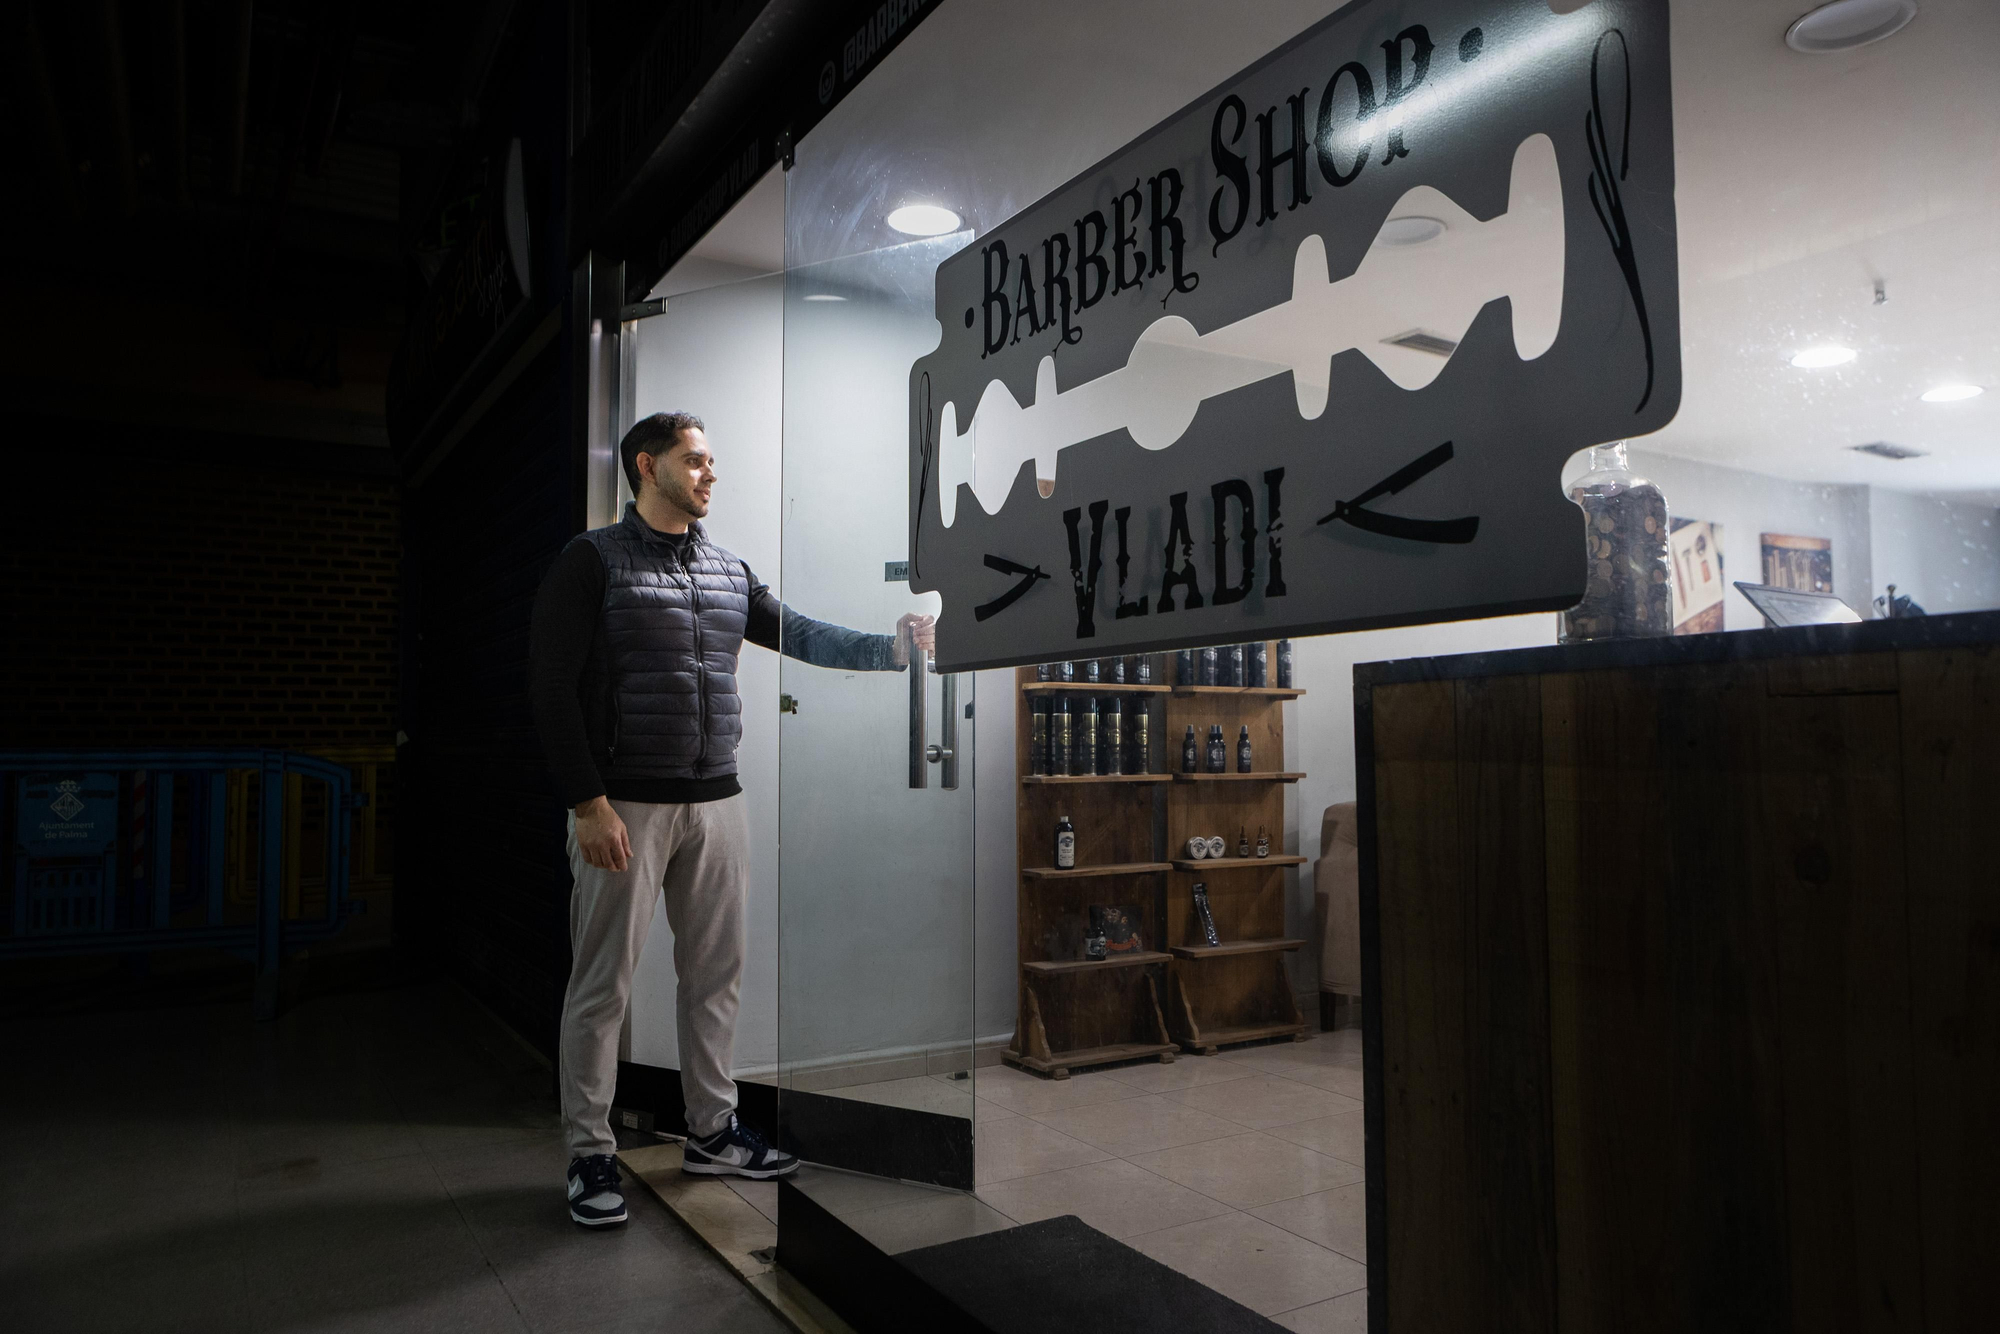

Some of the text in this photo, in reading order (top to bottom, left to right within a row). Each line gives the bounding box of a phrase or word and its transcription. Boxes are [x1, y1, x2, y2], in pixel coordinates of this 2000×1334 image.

[980, 23, 1436, 360] BARBER SHOP
[1062, 466, 1288, 639] VLADI
[39, 821, 95, 831] Ajuntament
[45, 831, 88, 839] de Palma
